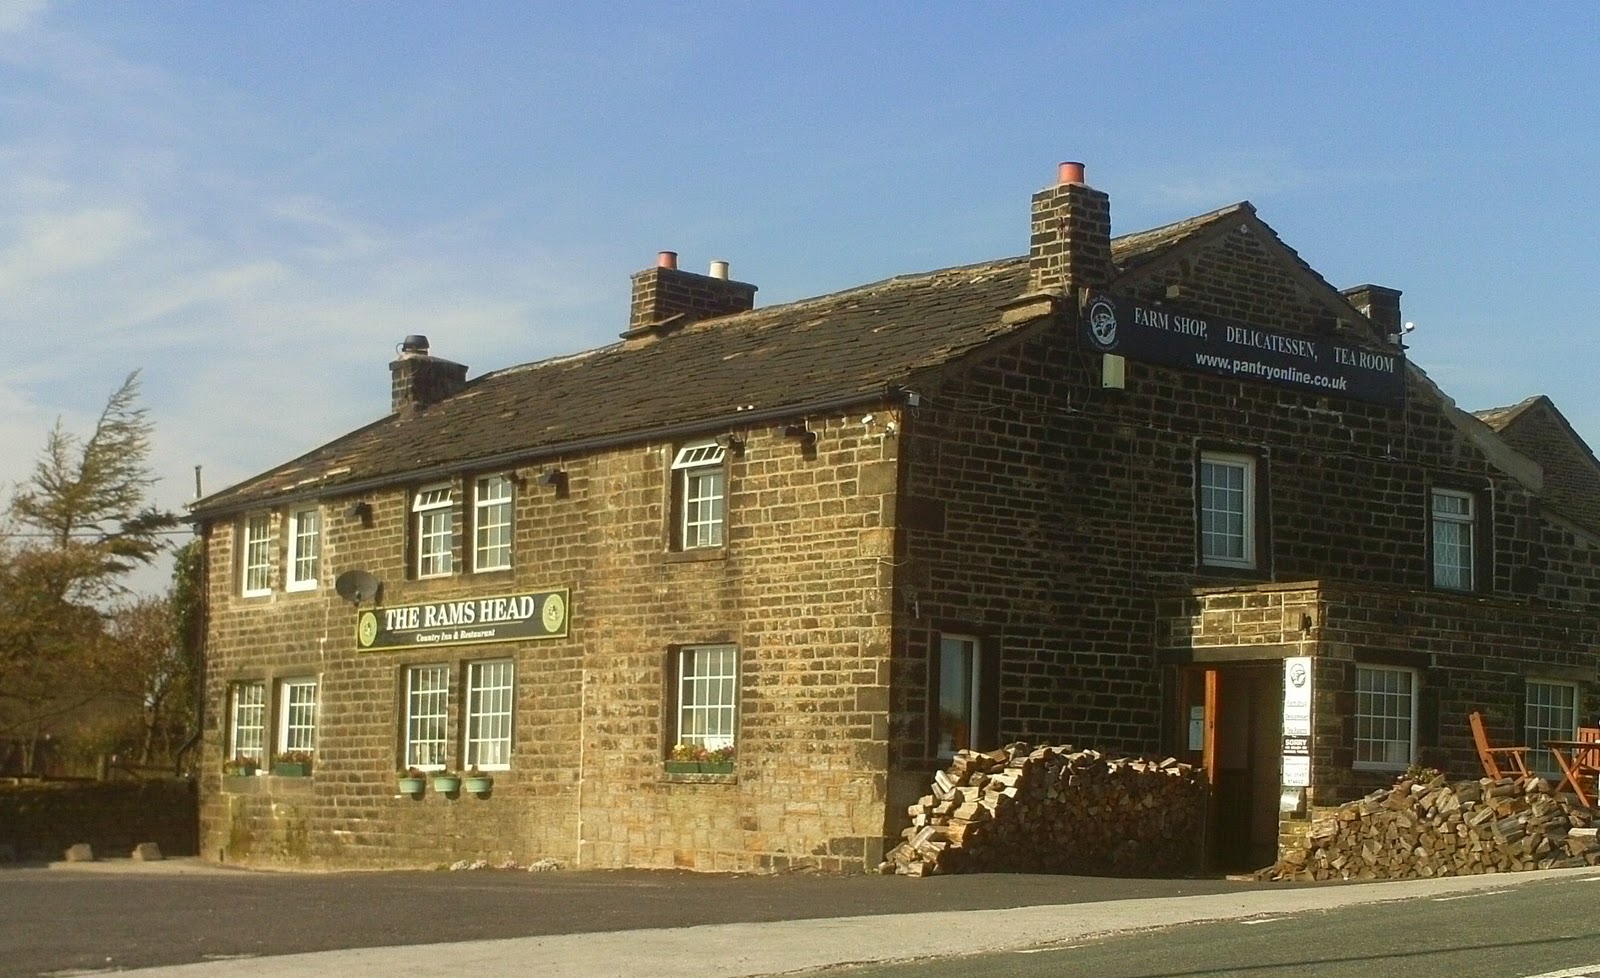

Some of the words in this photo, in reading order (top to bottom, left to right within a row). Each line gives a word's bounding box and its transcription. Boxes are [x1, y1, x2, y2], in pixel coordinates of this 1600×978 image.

[1134, 307, 1169, 330] FARM
[1173, 316, 1208, 340] SHOP,
[1226, 326, 1318, 362] DELICATESSEN,
[1333, 346, 1357, 366] TEA
[1359, 352, 1394, 373] ROOM
[1195, 353, 1348, 390] www.pantryonline.co.uk
[385, 606, 420, 630] THE
[424, 601, 476, 627] RAMS
[479, 596, 535, 622] HEAD
[416, 633, 440, 643] Country
[441, 632, 453, 641] Inn
[453, 631, 459, 640] &
[460, 629, 496, 639] Restaurant
